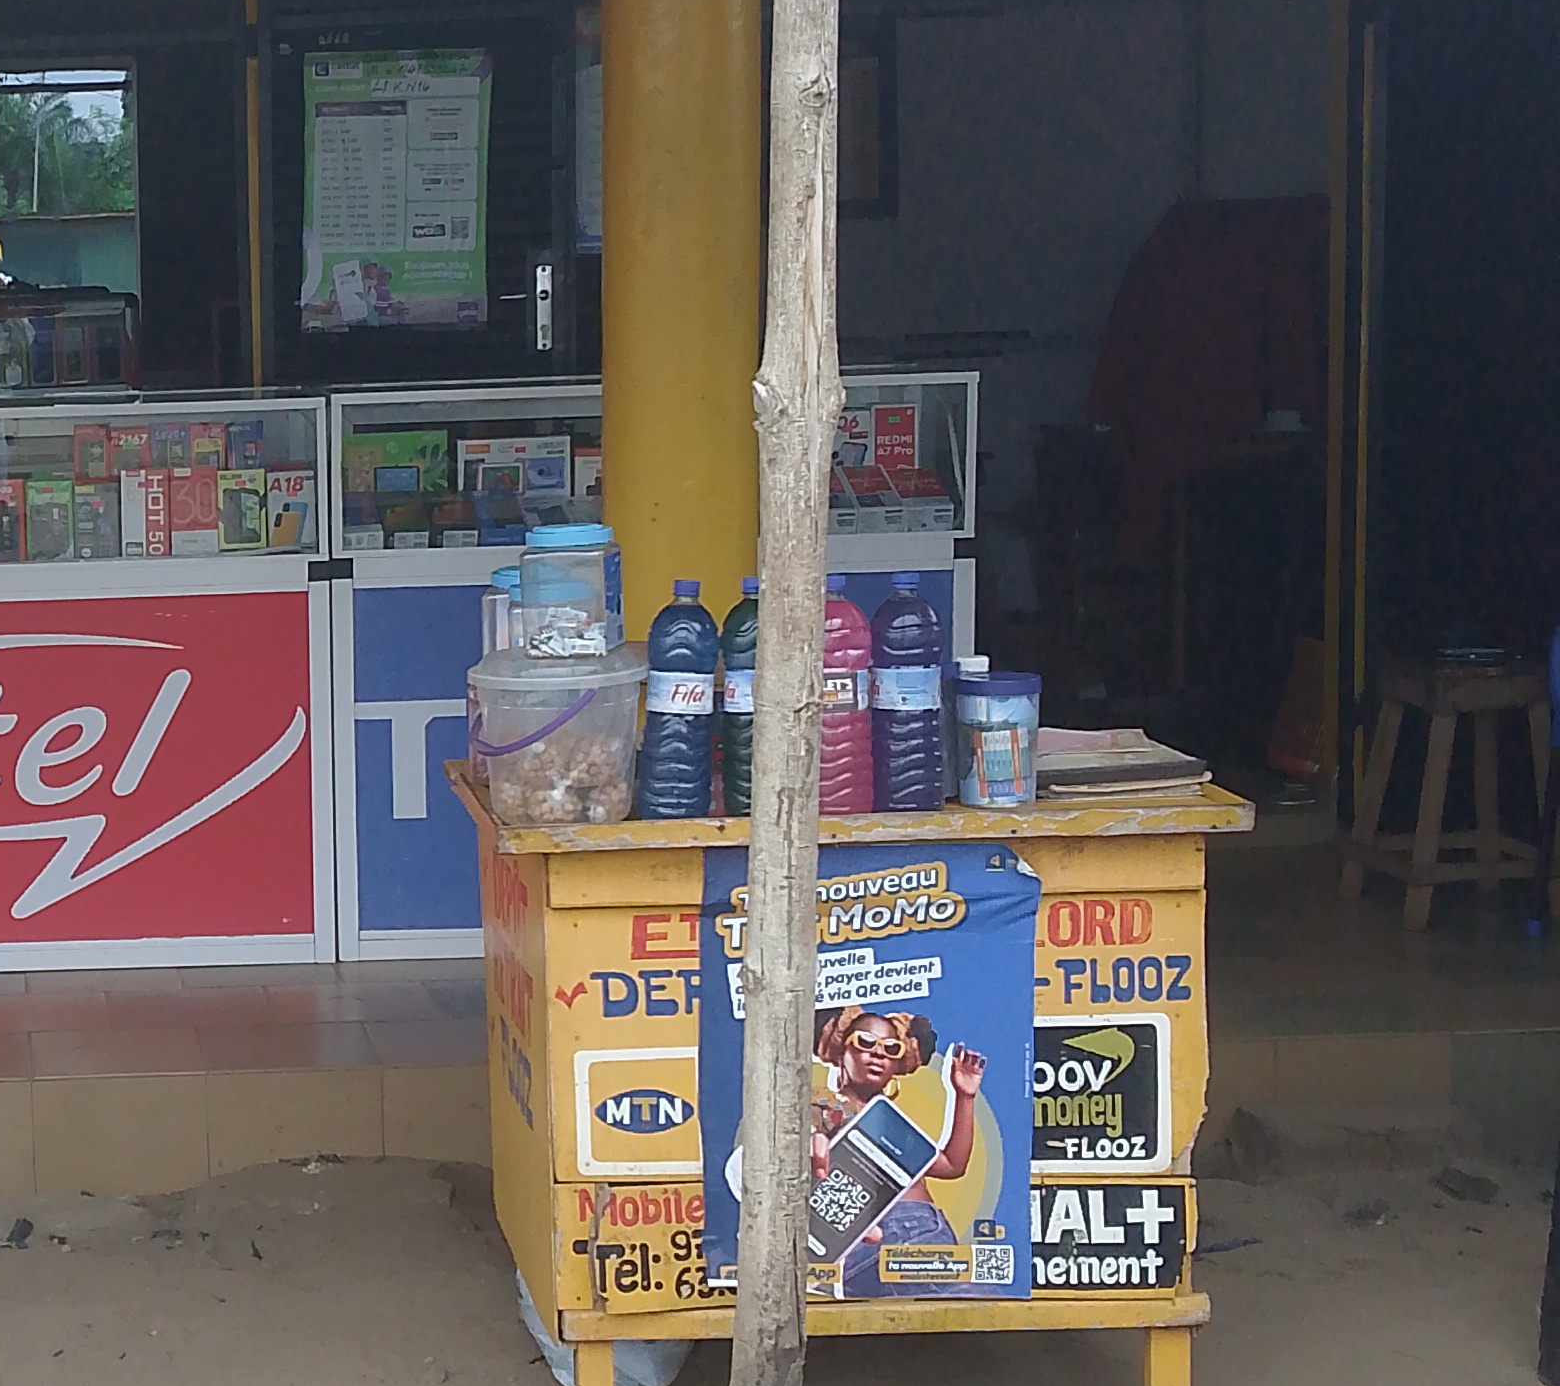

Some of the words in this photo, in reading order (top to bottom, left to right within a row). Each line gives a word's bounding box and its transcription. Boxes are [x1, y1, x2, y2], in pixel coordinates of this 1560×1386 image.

[876, 434, 913, 446] REDMI
[893, 446, 914, 456] Pro
[268, 475, 305, 493] A18
[147, 474, 164, 525] HOT
[171, 477, 217, 524] 30
[148, 530, 164, 556] 50
[671, 682, 705, 705] Fifa
[816, 869, 937, 903] nouveau
[631, 913, 700, 959] ET
[1035, 898, 1153, 948] ORD
[828, 894, 956, 934] MoMo
[819, 952, 867, 969] uvelle
[824, 968, 871, 989] payer
[873, 959, 936, 980] devient
[590, 970, 702, 1018] DEP
[828, 987, 851, 1001] via
[855, 983, 881, 999] QR
[883, 979, 923, 995] code
[1033, 1059, 1113, 1092] OOV
[605, 1096, 684, 1125] MTN
[946, 1261, 968, 1272] App
